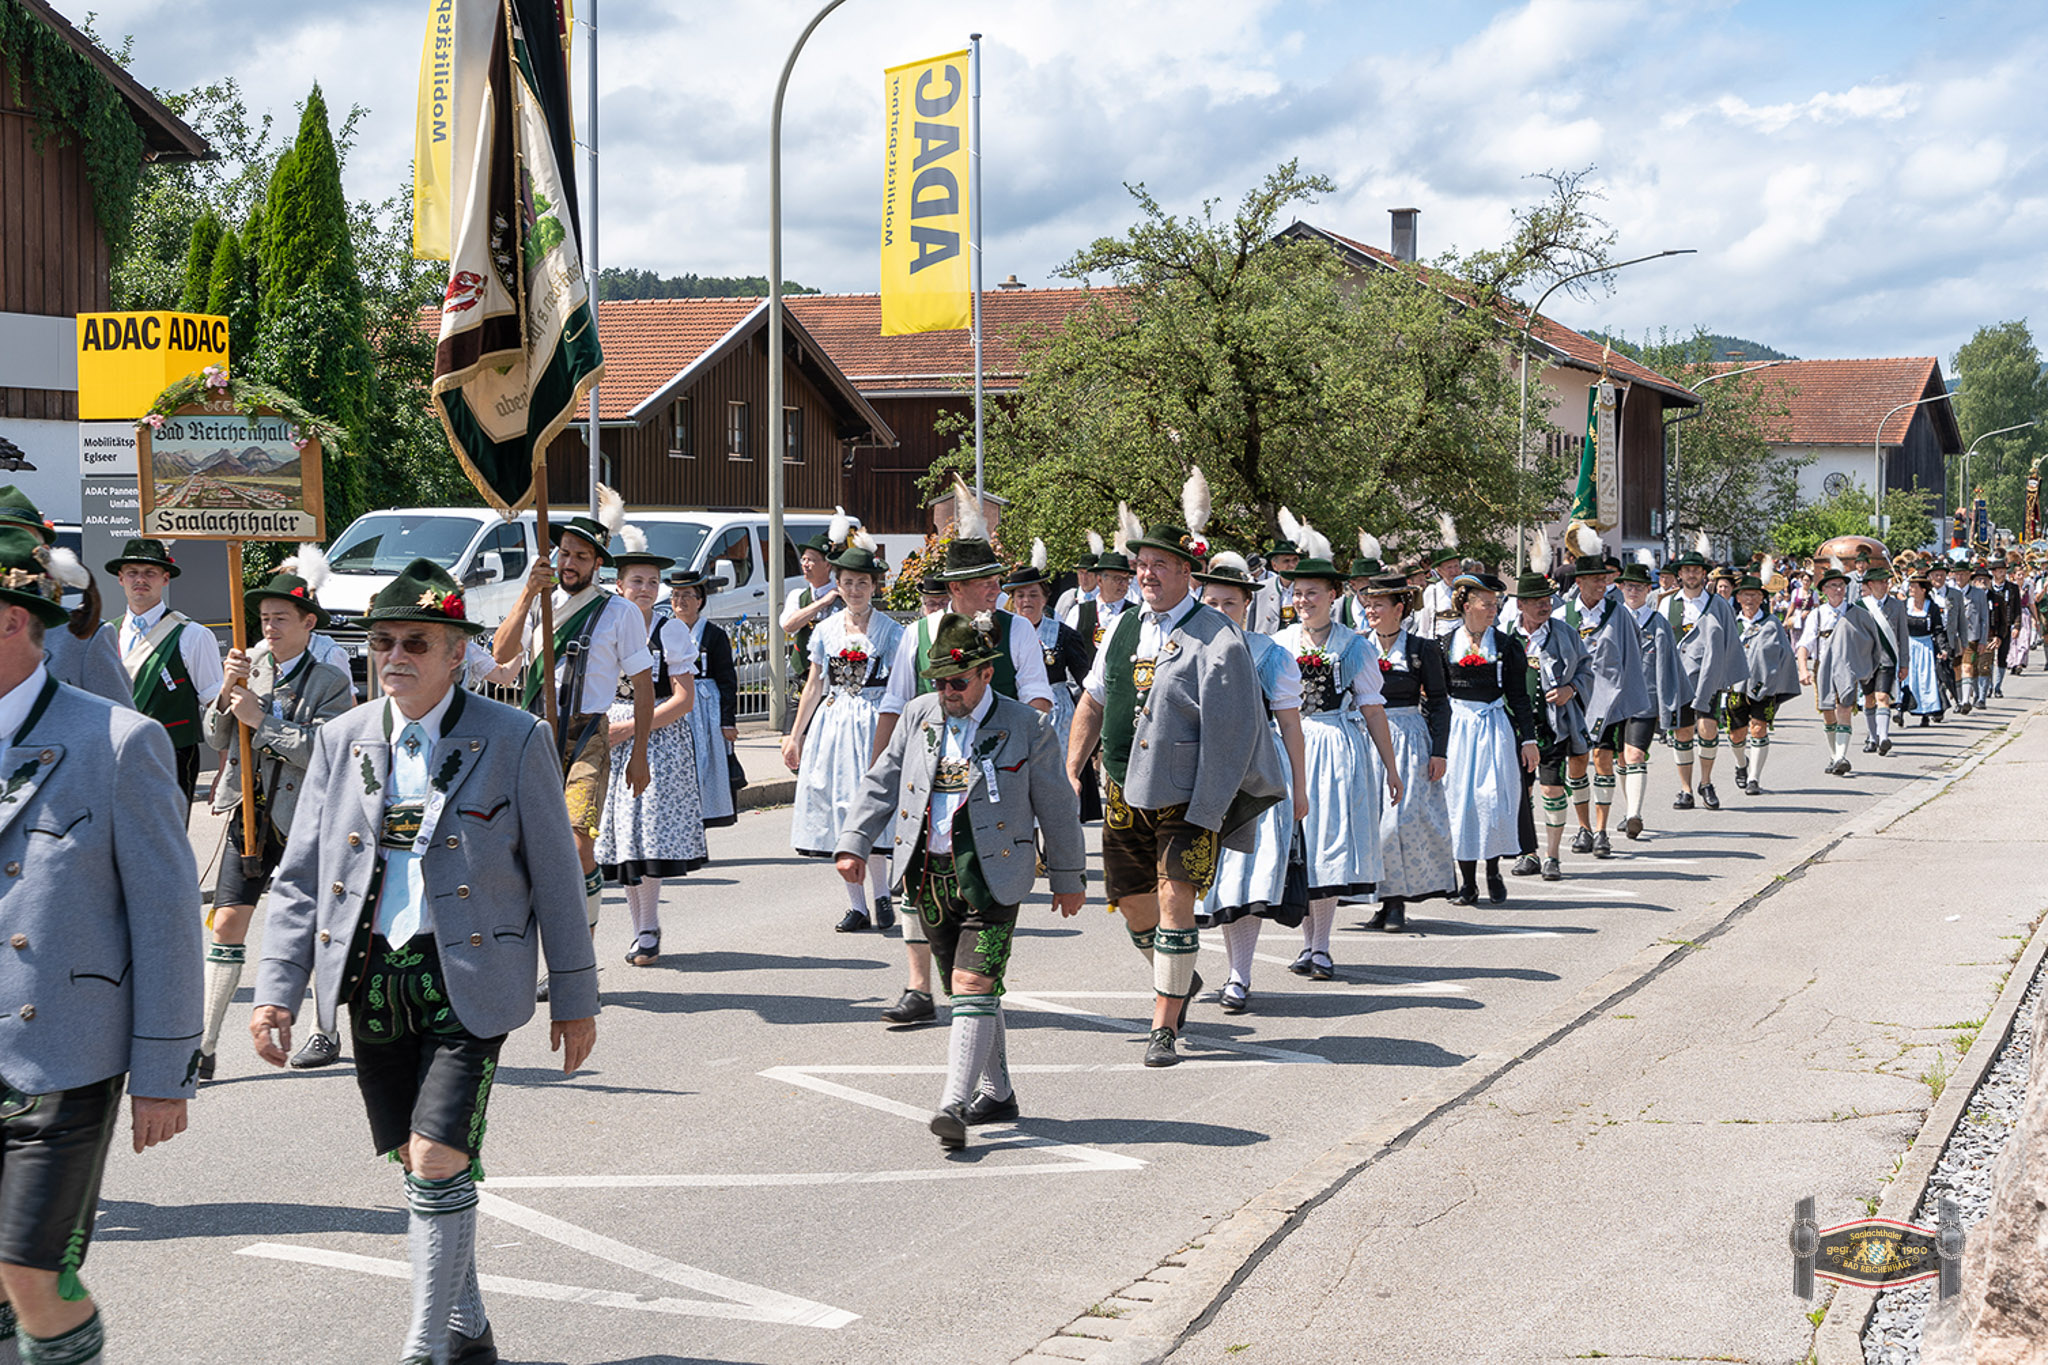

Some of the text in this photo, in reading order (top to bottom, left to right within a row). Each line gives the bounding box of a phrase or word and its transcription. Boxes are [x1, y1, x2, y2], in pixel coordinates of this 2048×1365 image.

[83, 316, 161, 351] ADAC
[168, 317, 226, 354] ADAC
[155, 421, 290, 444] Bad Reichenhall
[84, 453, 117, 464] Eglseer
[85, 487, 108, 496] ADAC
[85, 516, 132, 525] ADAC Auto-
[155, 510, 300, 535] Saalachthaler
